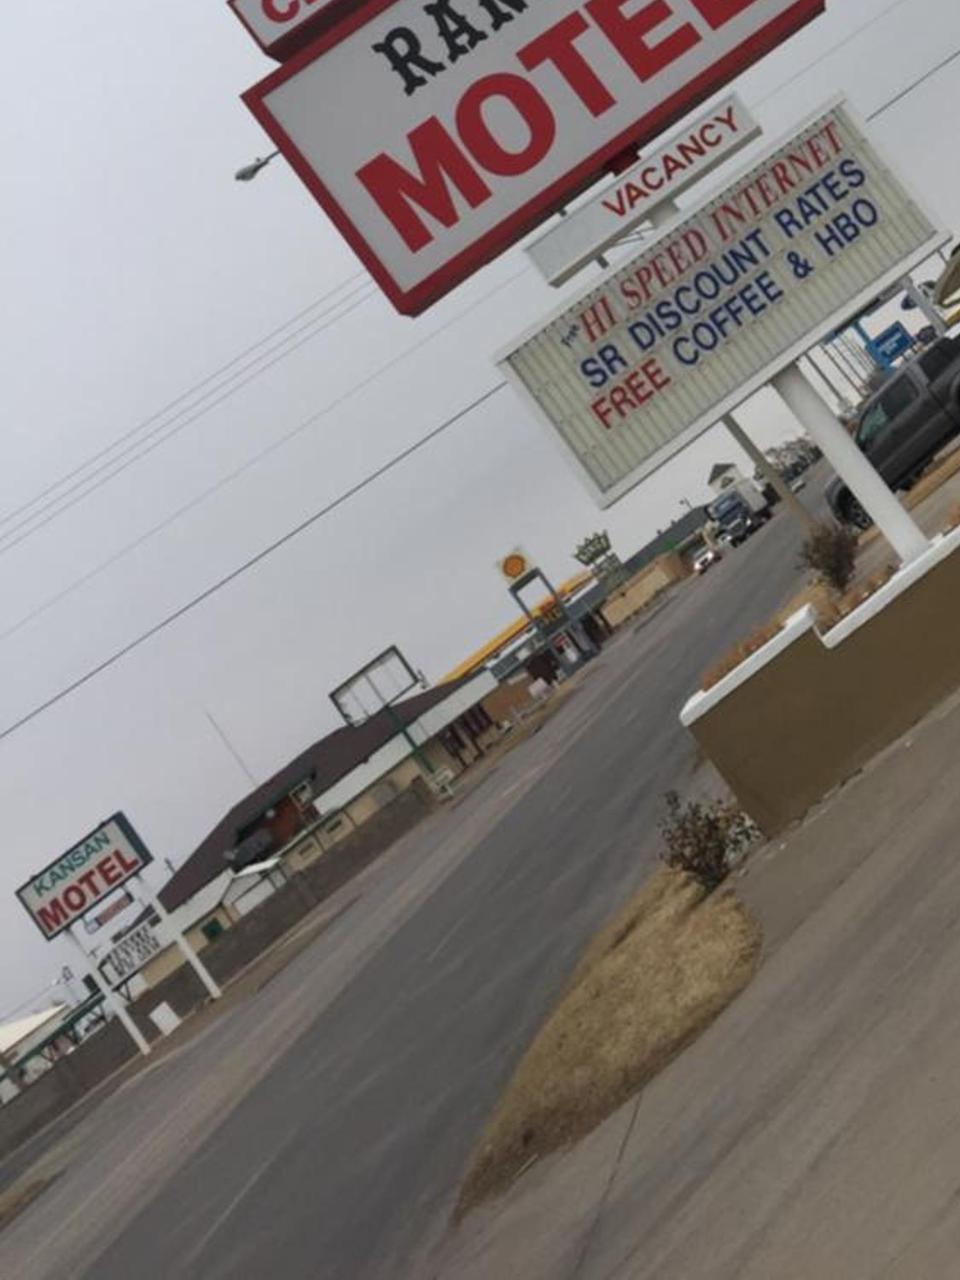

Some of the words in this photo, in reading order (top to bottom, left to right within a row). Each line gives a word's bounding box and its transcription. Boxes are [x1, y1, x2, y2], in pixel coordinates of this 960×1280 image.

[580, 296, 617, 342] HI
[621, 225, 709, 311] SPEED
[712, 120, 842, 242] INTERNET
[602, 106, 741, 218] VACANCY
[580, 345, 628, 390] SR
[627, 228, 772, 350] DISCOUNT
[773, 158, 867, 239] RATES
[591, 359, 672, 429] FREE
[672, 272, 785, 367] COFFEE
[787, 250, 814, 279] &
[816, 198, 879, 257] HBO
[32, 831, 111, 898] KANSAN
[37, 849, 139, 932] MOTEL
